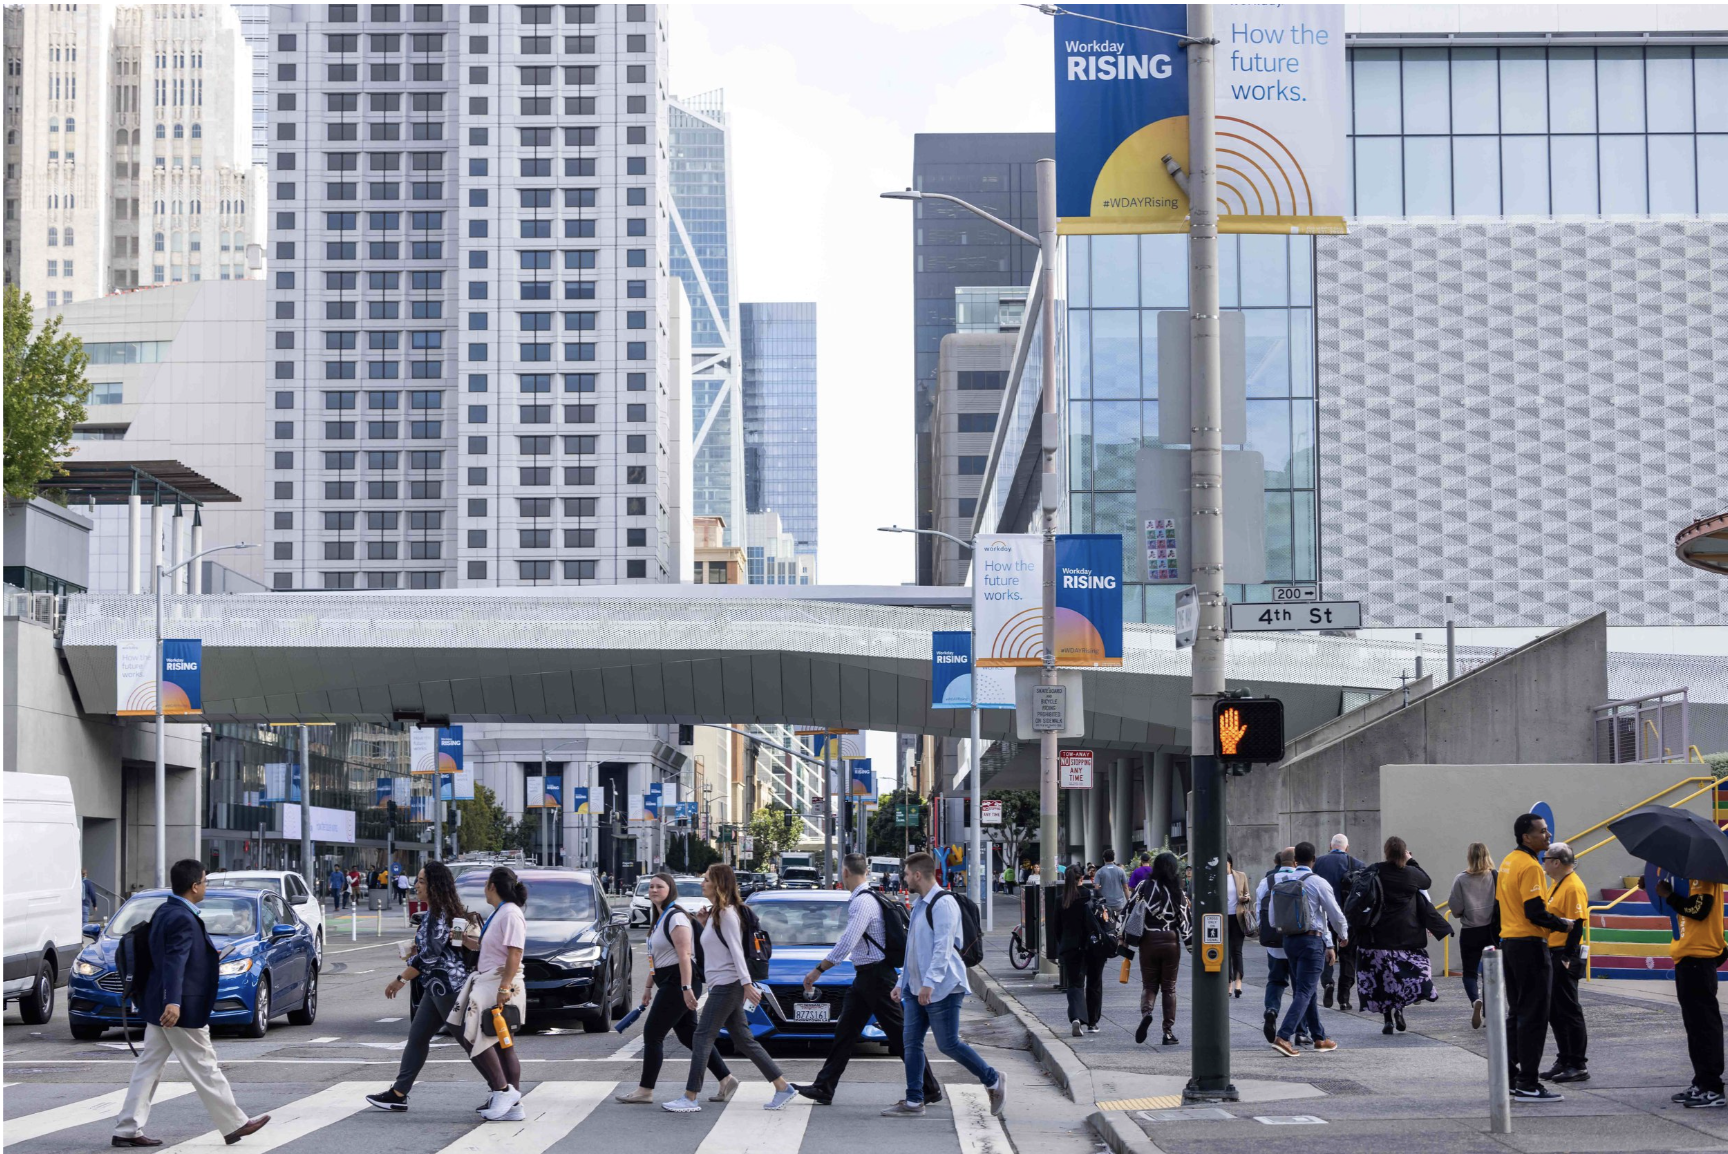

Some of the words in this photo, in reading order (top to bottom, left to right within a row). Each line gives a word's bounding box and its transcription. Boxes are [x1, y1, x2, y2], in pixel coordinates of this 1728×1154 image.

[1231, 22, 1284, 44] How
[1291, 23, 1328, 45] the
[1065, 40, 1124, 55] Workday
[1067, 54, 1172, 81] RISING
[1231, 51, 1299, 72] future
[1231, 79, 1306, 102] works.
[1103, 197, 1178, 209] #WDAYRising
[985, 560, 1011, 571] How
[1015, 560, 1034, 571] the
[1062, 568, 1092, 576] Workday
[984, 574, 1019, 586] future
[1063, 575, 1116, 589] RISING
[984, 589, 1023, 600] works.
[1277, 588, 1301, 599] 200
[1258, 609, 1291, 625] 4th
[1309, 608, 1332, 624] St
[936, 655, 968, 664] RISING
[166, 662, 197, 671] RISING
[1061, 757, 1069, 766] NO
